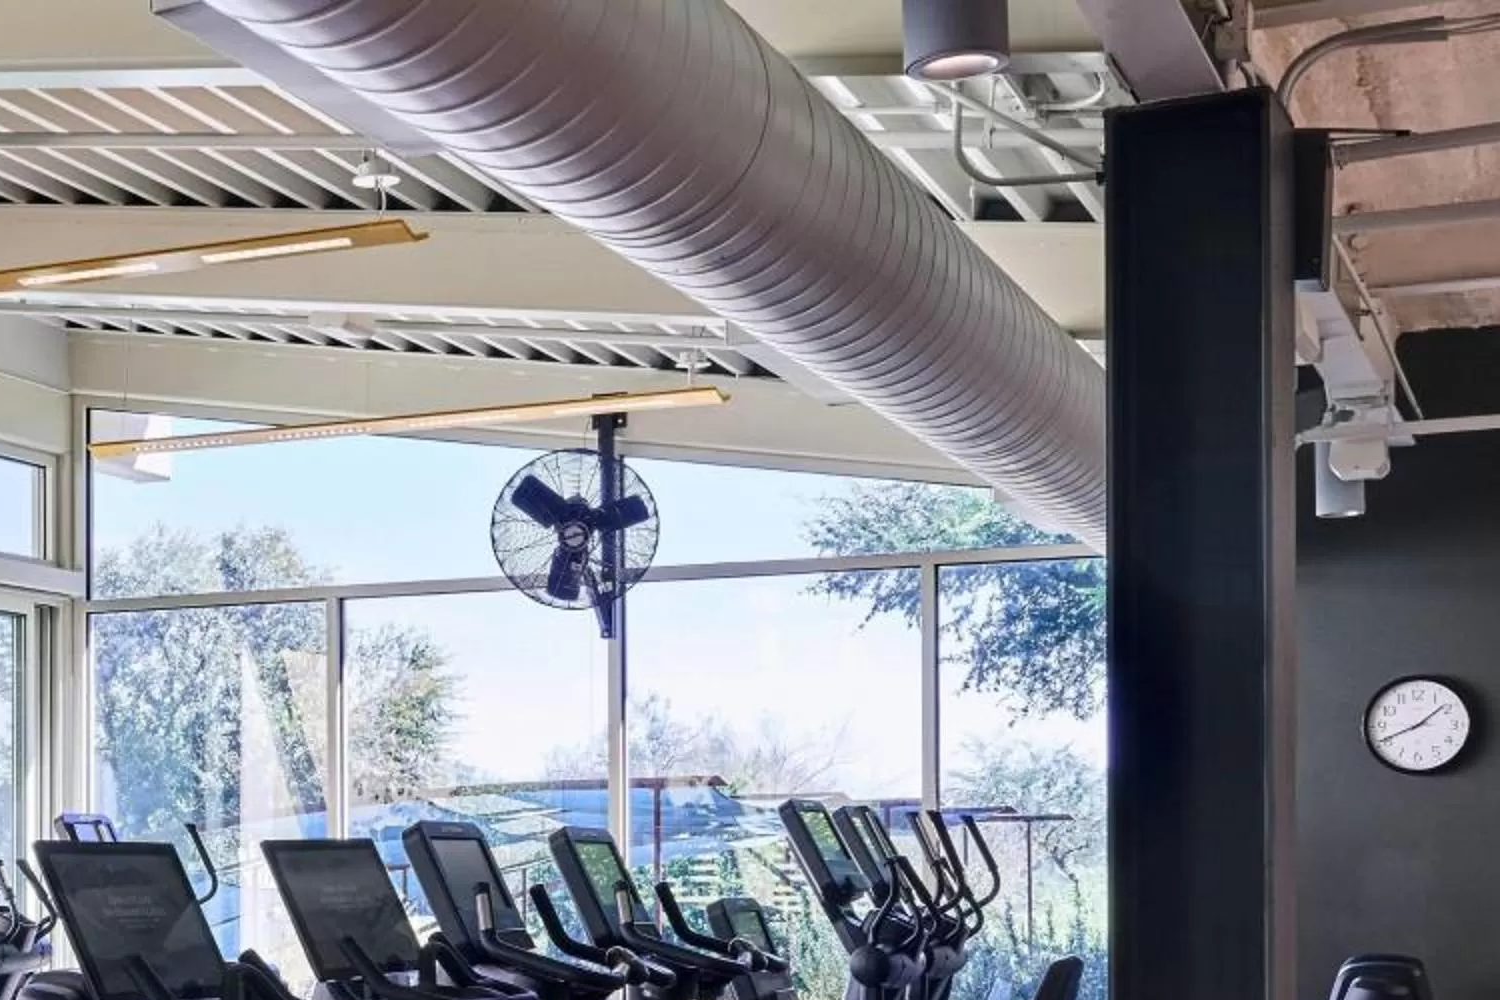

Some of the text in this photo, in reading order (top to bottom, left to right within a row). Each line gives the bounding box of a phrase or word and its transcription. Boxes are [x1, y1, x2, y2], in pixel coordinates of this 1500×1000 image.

[1396, 692, 1407, 704] 11
[1411, 689, 1426, 701] 12
[1383, 705, 1397, 717] 10
[1378, 720, 1387, 733] 9
[1450, 719, 1460, 731] 3
